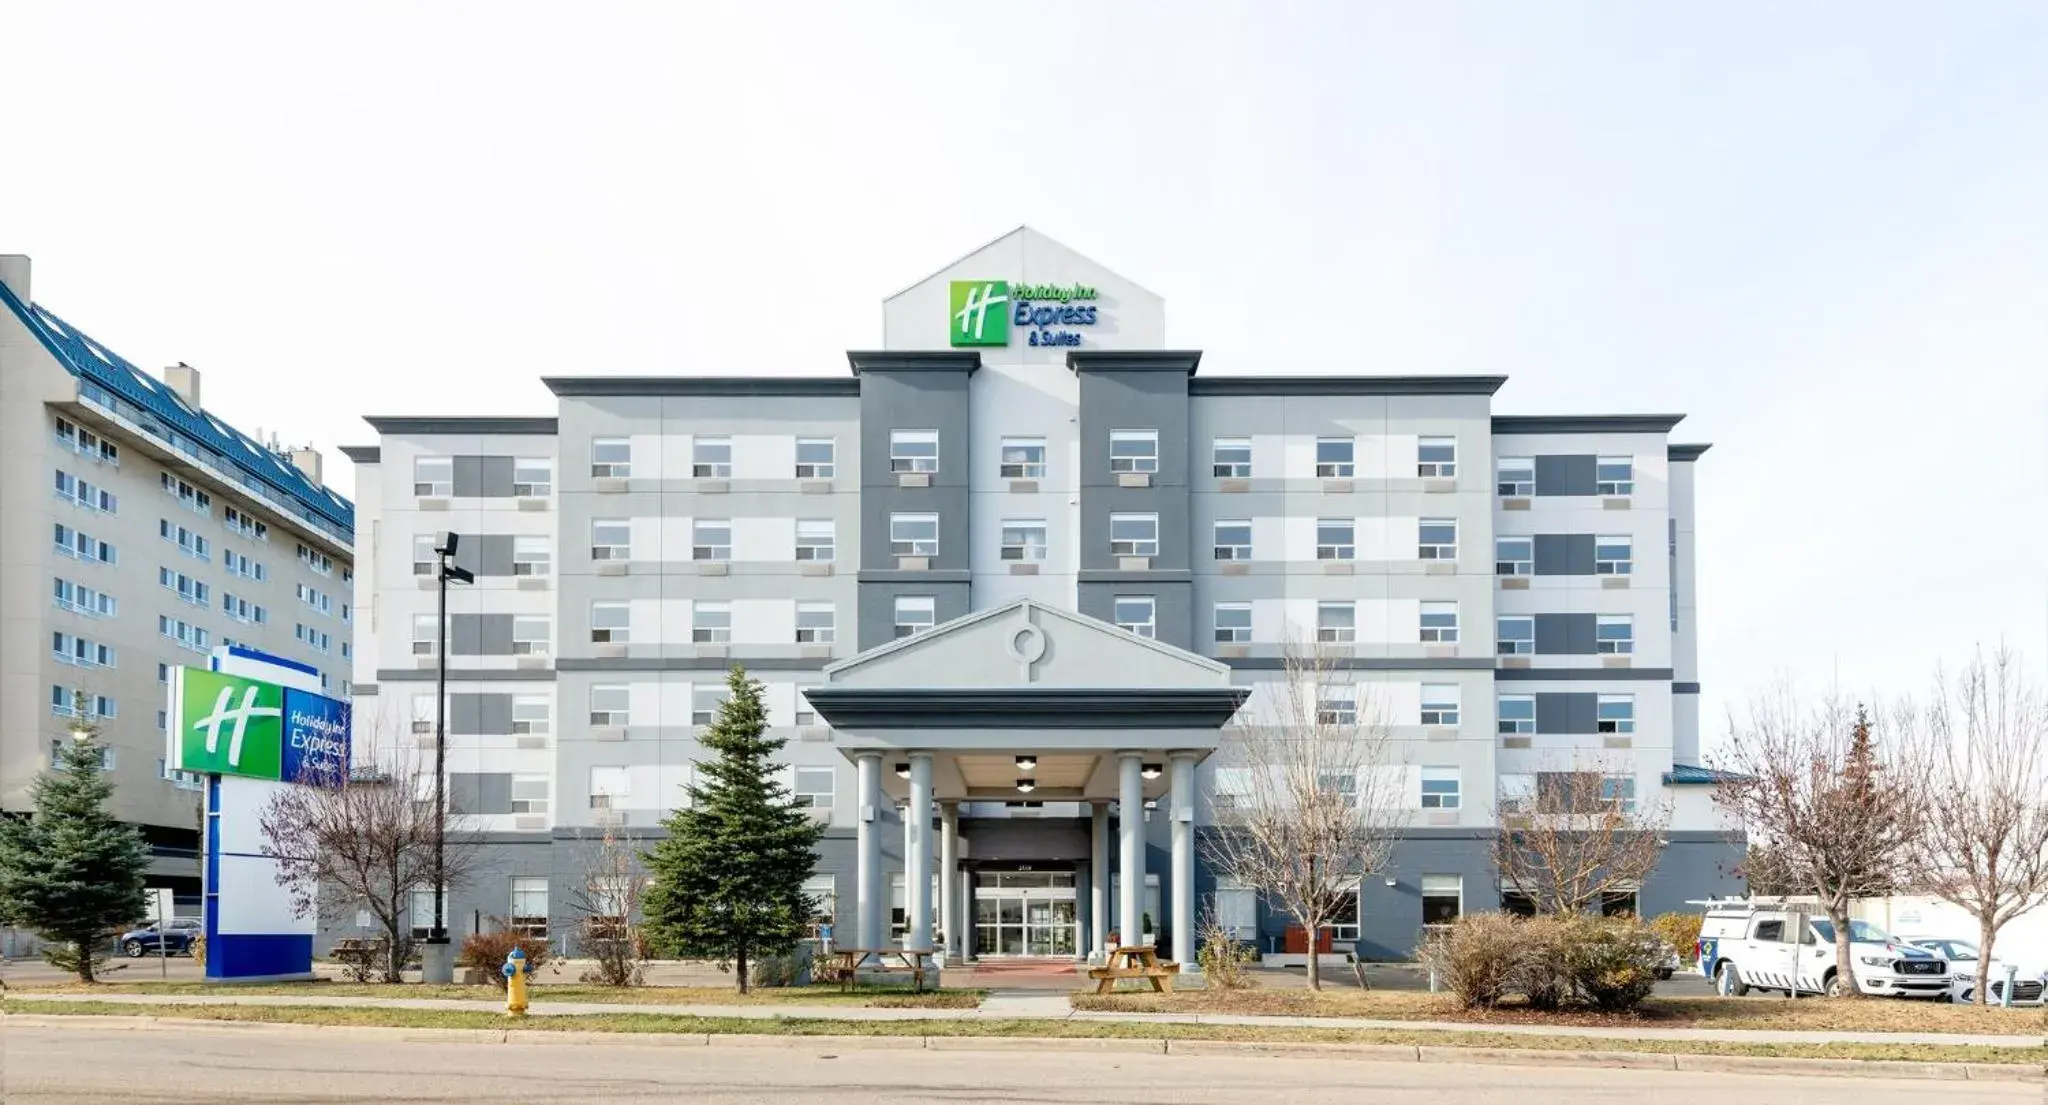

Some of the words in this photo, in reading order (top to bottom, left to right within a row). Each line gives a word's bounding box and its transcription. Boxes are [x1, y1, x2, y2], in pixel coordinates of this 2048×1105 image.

[1011, 282, 1071, 303] Holiday
[1073, 282, 1097, 300] Inn
[1014, 301, 1097, 330] Express
[1028, 332, 1038, 346] &
[1041, 330, 1081, 346] Suites
[291, 710, 332, 735] Holiday
[291, 727, 346, 758] Express
